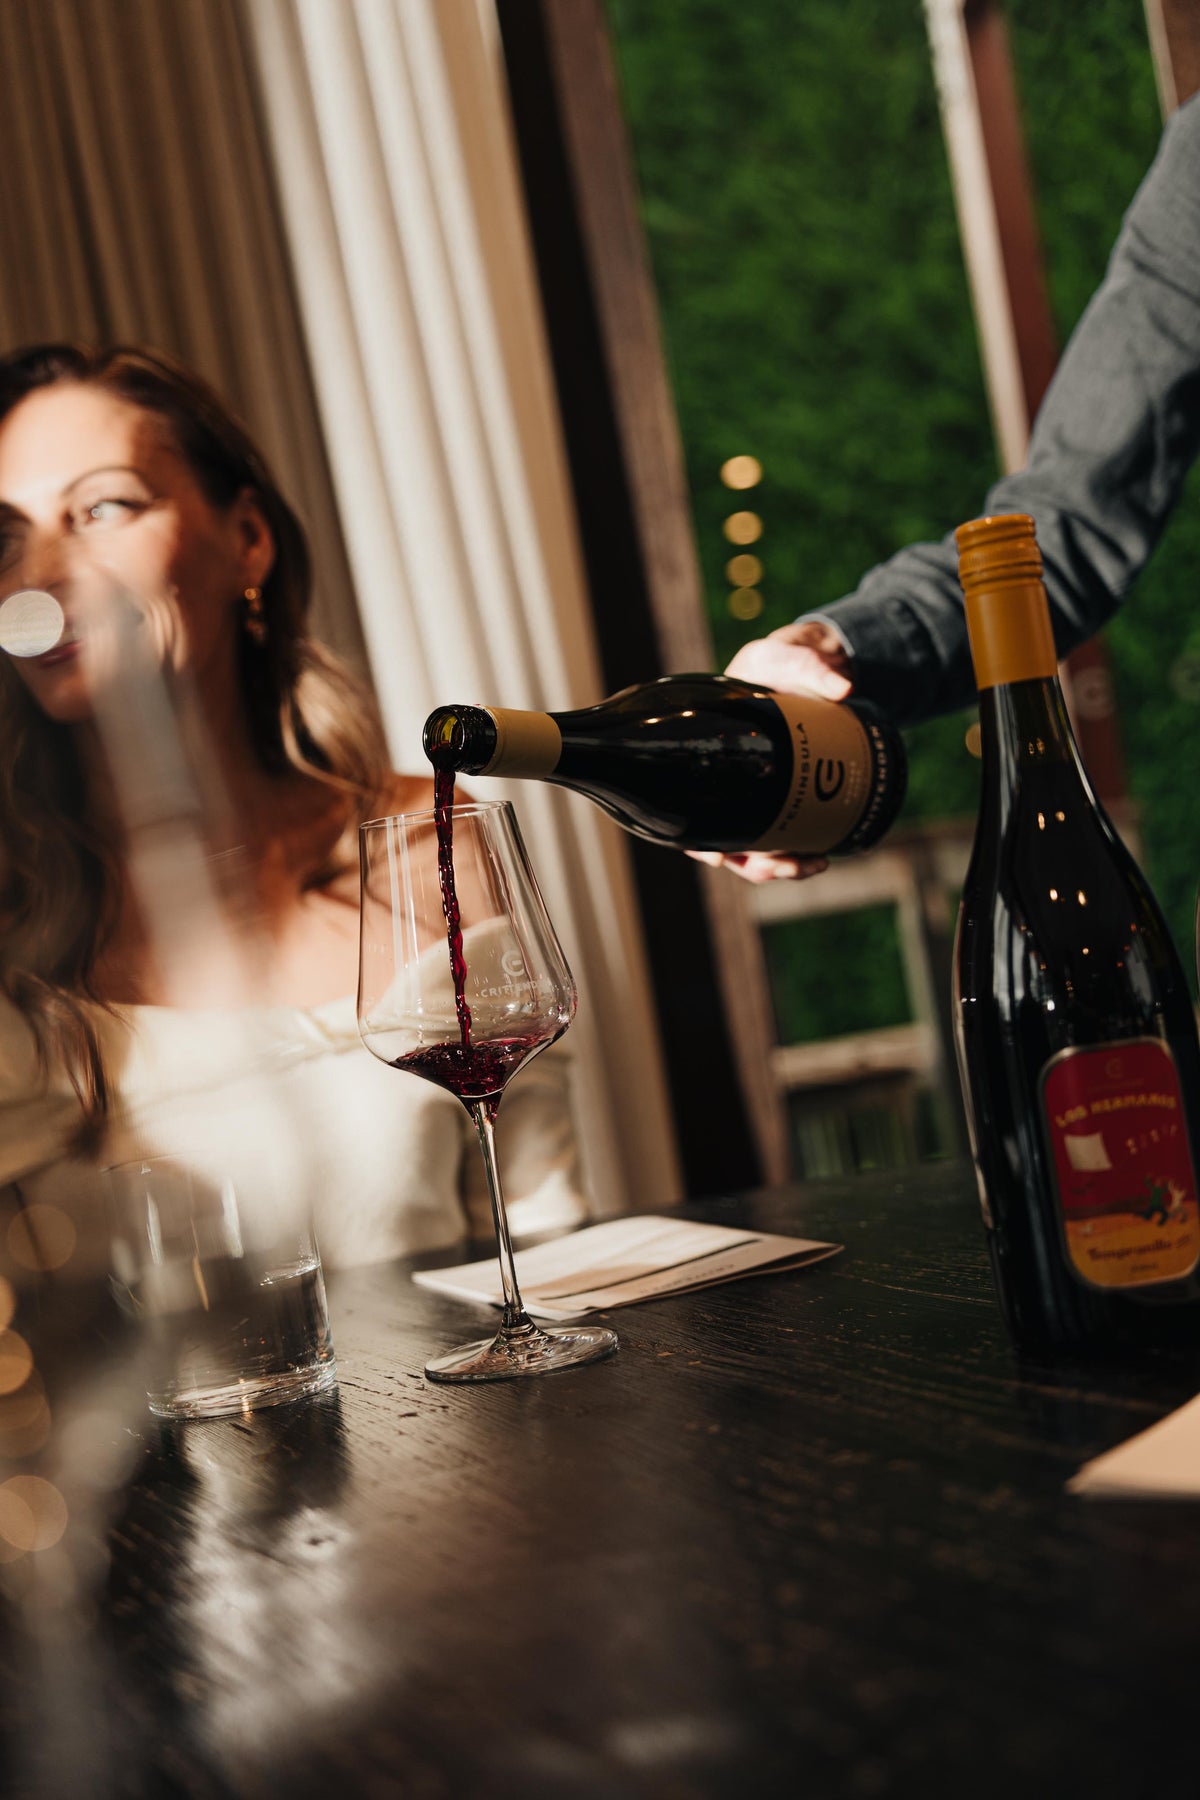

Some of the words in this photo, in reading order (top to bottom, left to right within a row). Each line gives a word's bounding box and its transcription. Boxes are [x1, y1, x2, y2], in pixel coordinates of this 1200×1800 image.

[777, 722, 810, 831] PENINSULA
[481, 980, 540, 998] CRITTEND
[1055, 1105, 1088, 1128] LOS
